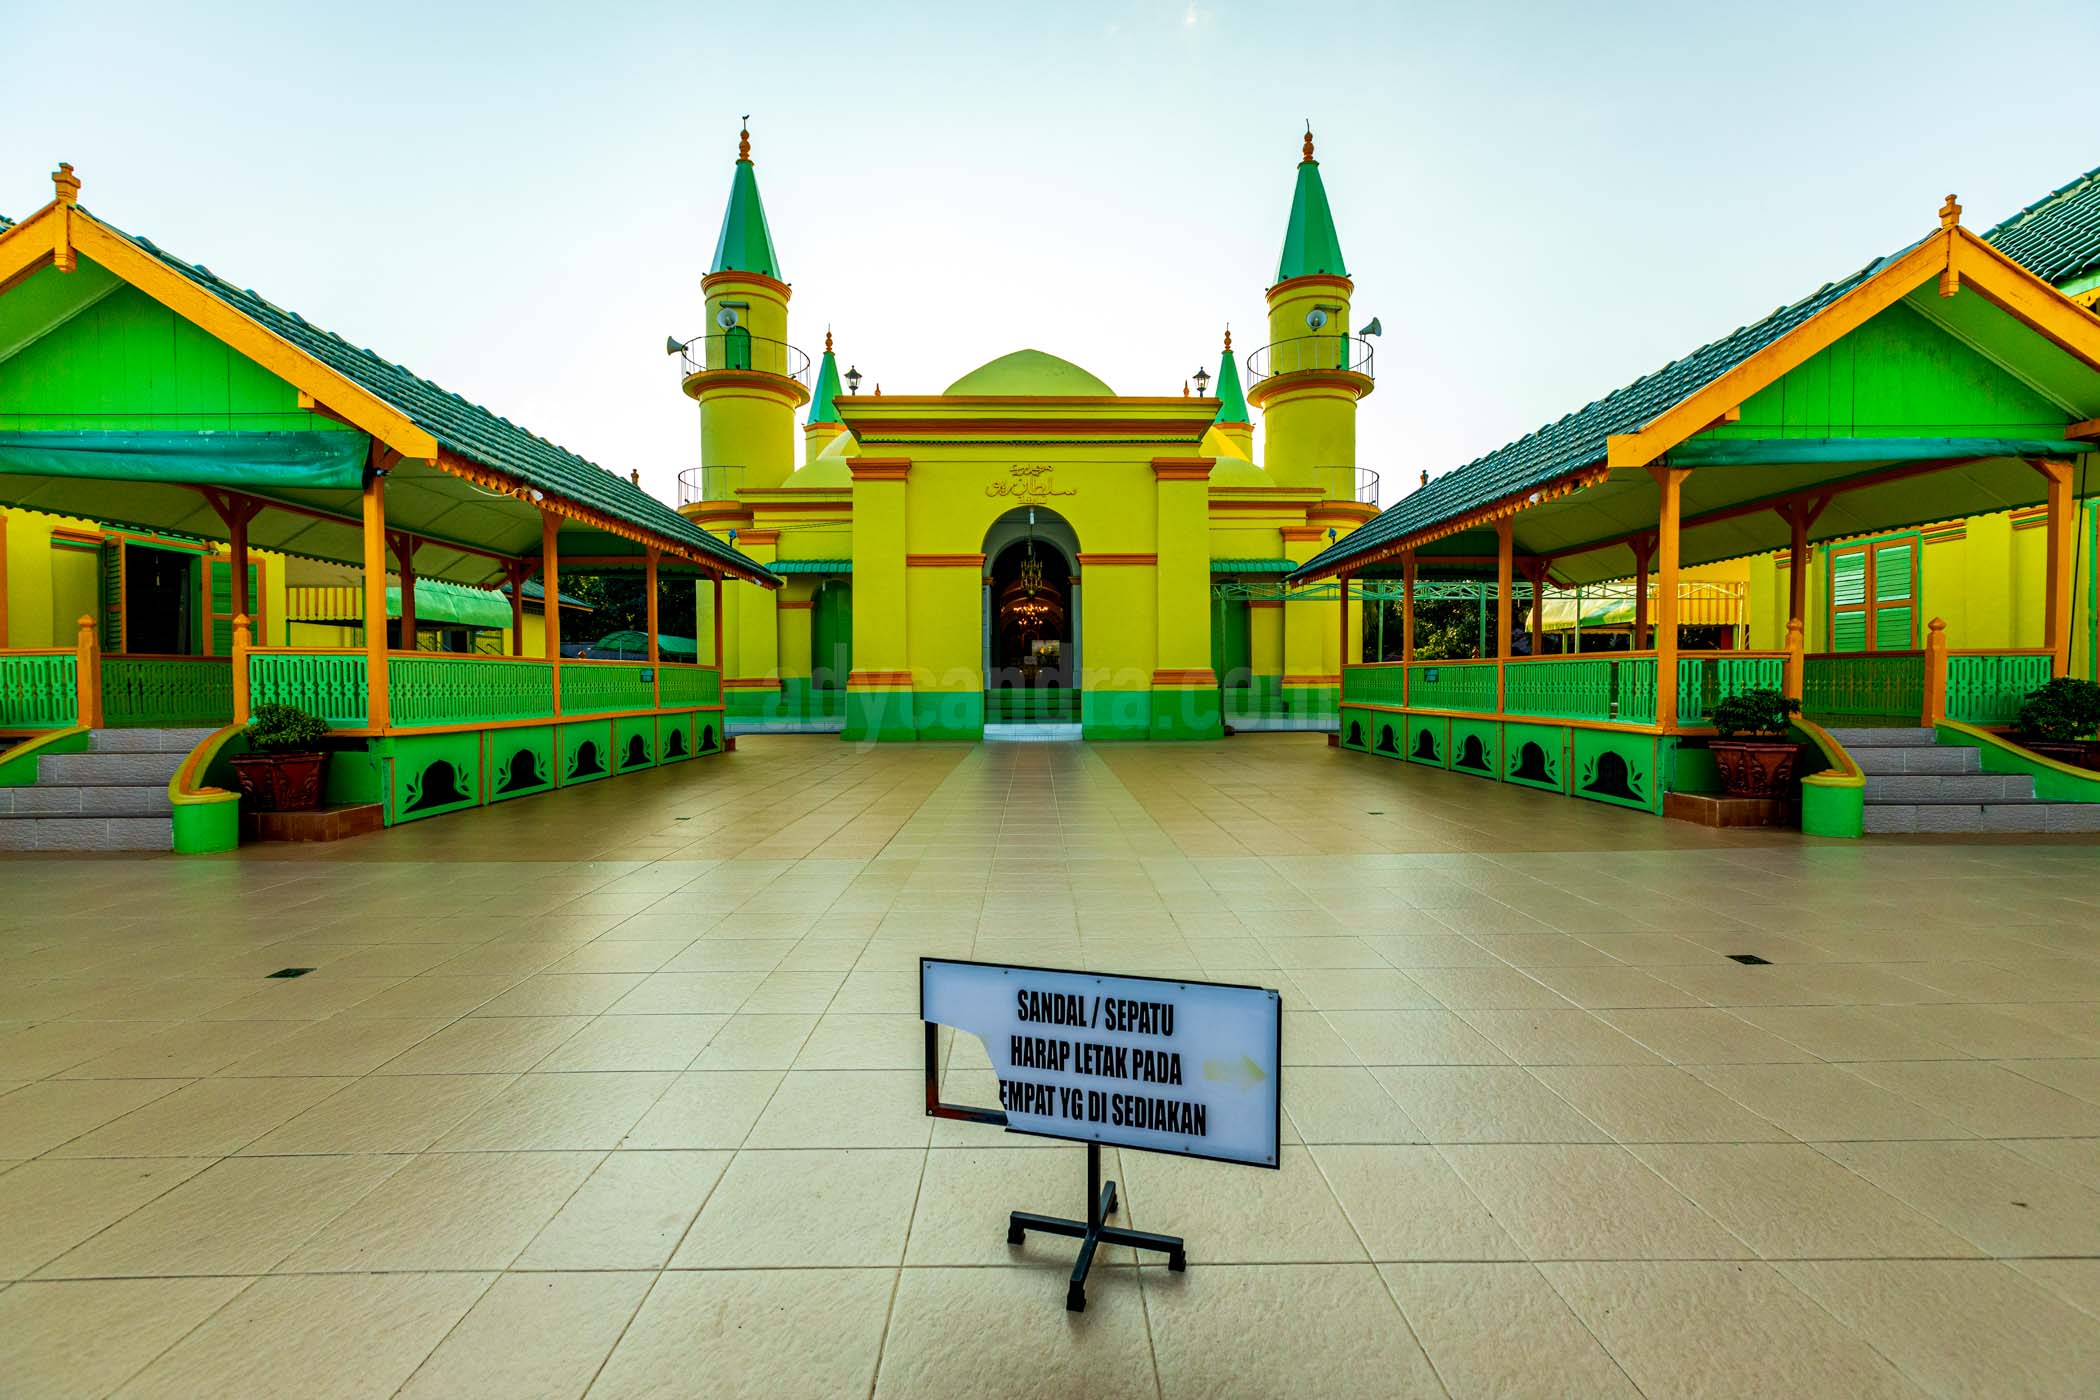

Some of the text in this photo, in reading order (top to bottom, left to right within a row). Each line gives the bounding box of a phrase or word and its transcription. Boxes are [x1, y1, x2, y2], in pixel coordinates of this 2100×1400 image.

[1018, 989, 1174, 1036] SANDAL / SEPATU
[1011, 1035, 1183, 1085] HARAP LETAK PADA
[999, 1079, 1206, 1137] EMPAT YG DI SEDIAKAN
